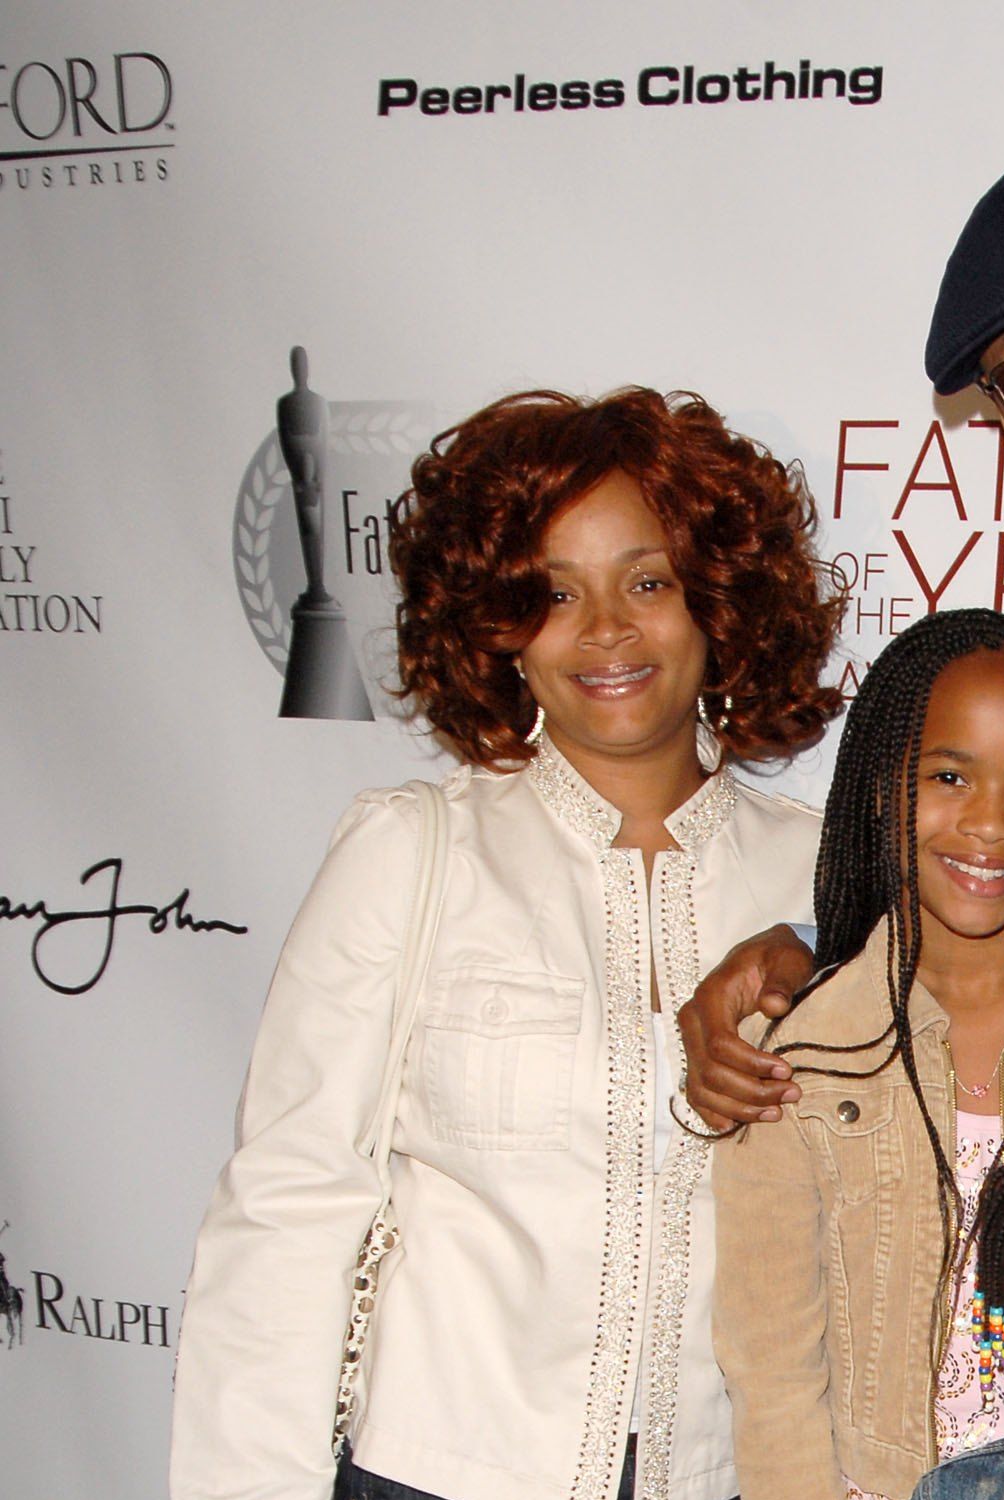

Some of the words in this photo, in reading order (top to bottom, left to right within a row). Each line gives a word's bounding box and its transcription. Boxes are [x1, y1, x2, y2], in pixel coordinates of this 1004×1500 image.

[0, 53, 172, 140] ORD
[377, 74, 626, 116] Peerless
[637, 60, 884, 106] Clothing
[0, 158, 168, 190] USTRIES
[831, 552, 888, 591] OF
[30, 1270, 171, 1348] RALPH
